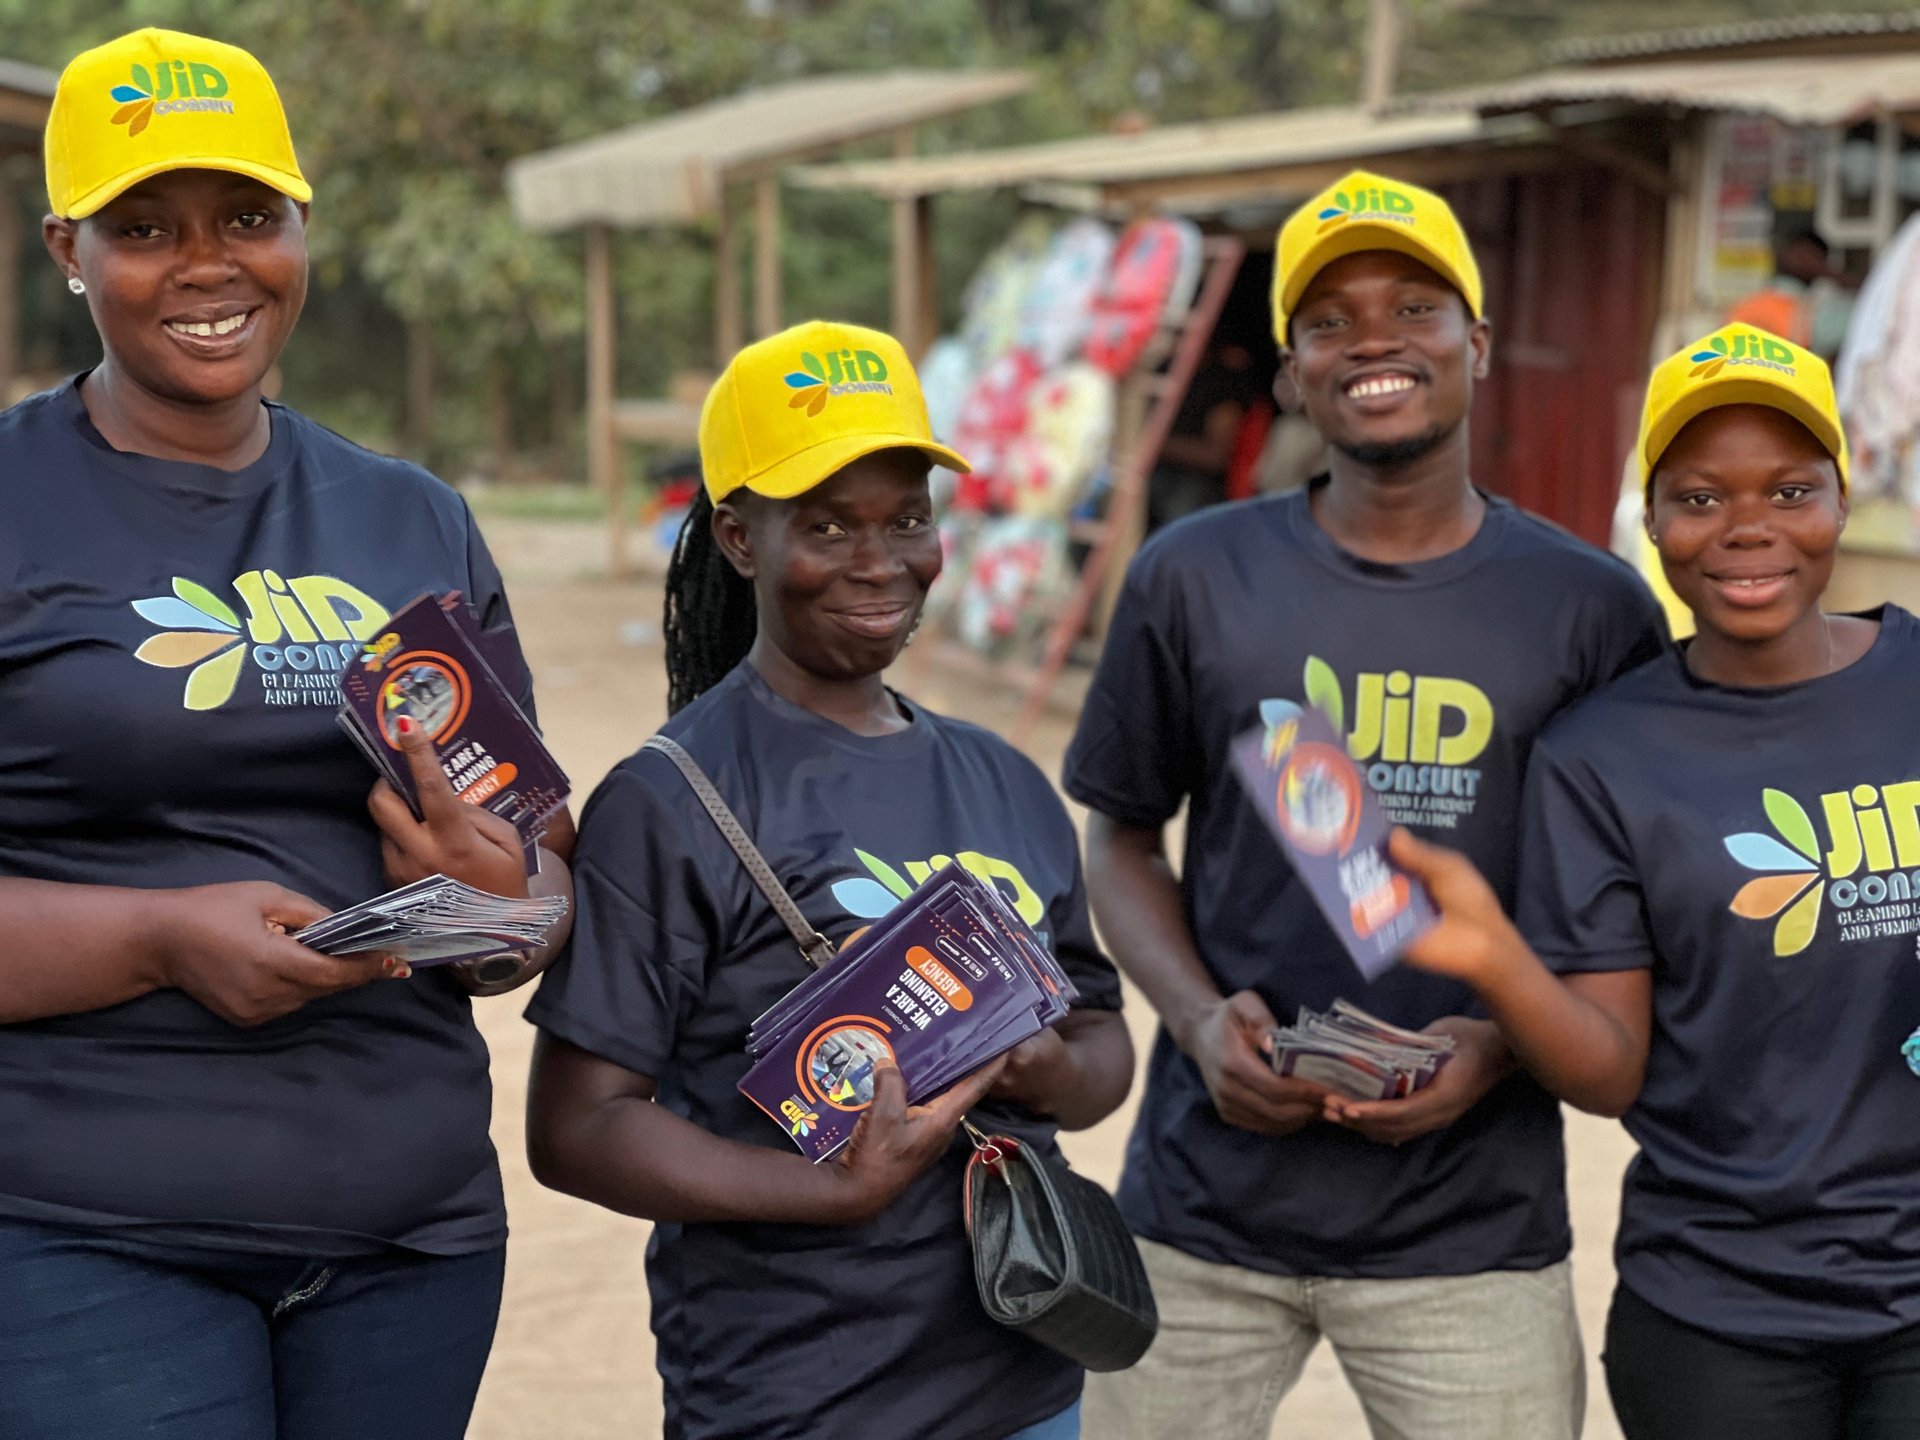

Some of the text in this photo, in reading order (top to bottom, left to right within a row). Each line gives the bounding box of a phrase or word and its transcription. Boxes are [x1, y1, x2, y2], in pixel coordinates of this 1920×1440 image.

[156, 59, 229, 100] JiD
[1352, 188, 1414, 213] JiD
[1730, 334, 1794, 365] JiD
[825, 349, 888, 386] JiD
[265, 690, 297, 705] AND
[1347, 670, 1494, 765] JiD
[450, 747, 477, 772] ARE
[471, 741, 487, 756] A
[452, 755, 497, 796] EANING
[462, 773, 500, 805] GENCY
[1364, 762, 1482, 797] ONSULT
[1838, 903, 1911, 926] CLEANING
[1841, 924, 1871, 941] AND
[899, 968, 949, 1017] CLEANING
[918, 958, 961, 997] AGENCY
[885, 983, 932, 1031] WE ARE A
